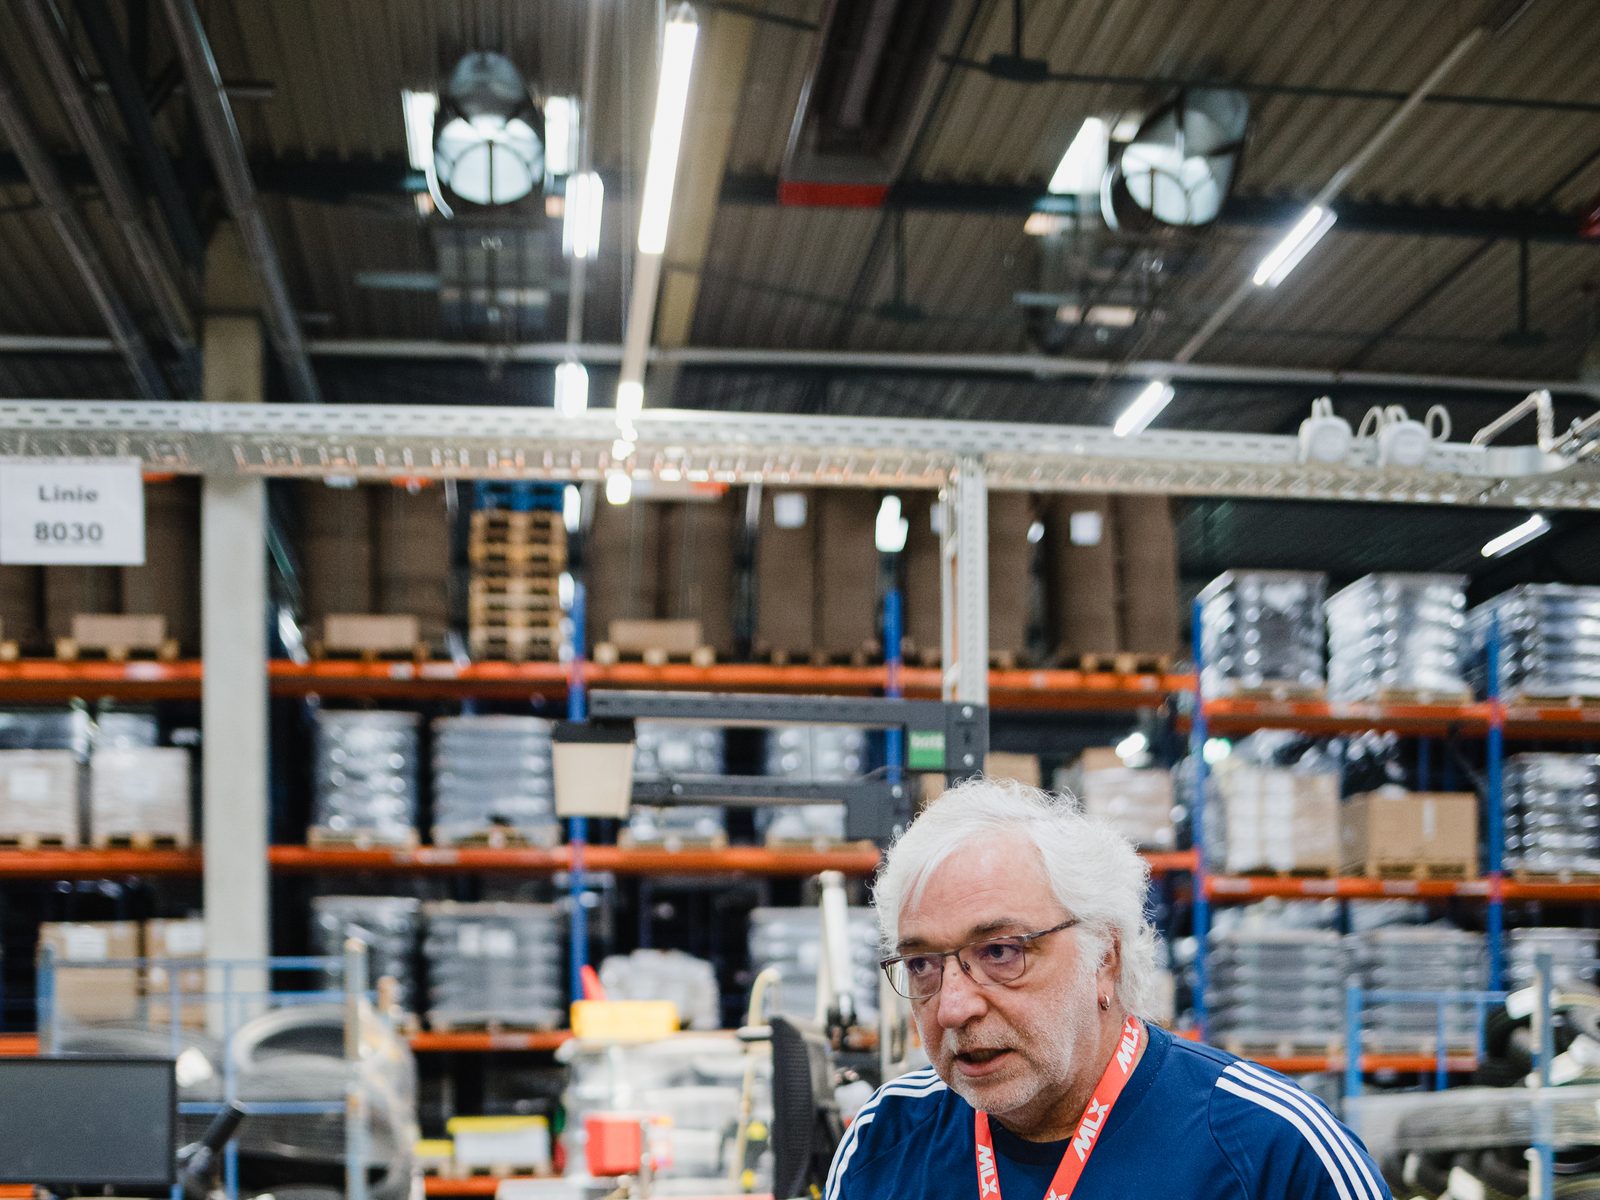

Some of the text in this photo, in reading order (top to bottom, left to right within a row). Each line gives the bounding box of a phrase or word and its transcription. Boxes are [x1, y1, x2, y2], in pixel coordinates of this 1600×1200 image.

[38, 485, 98, 501] Linie
[34, 522, 104, 542] 8030
[1116, 1021, 1139, 1074] MLX
[1072, 1097, 1110, 1163] MLX
[977, 1143, 998, 1198] MLX
